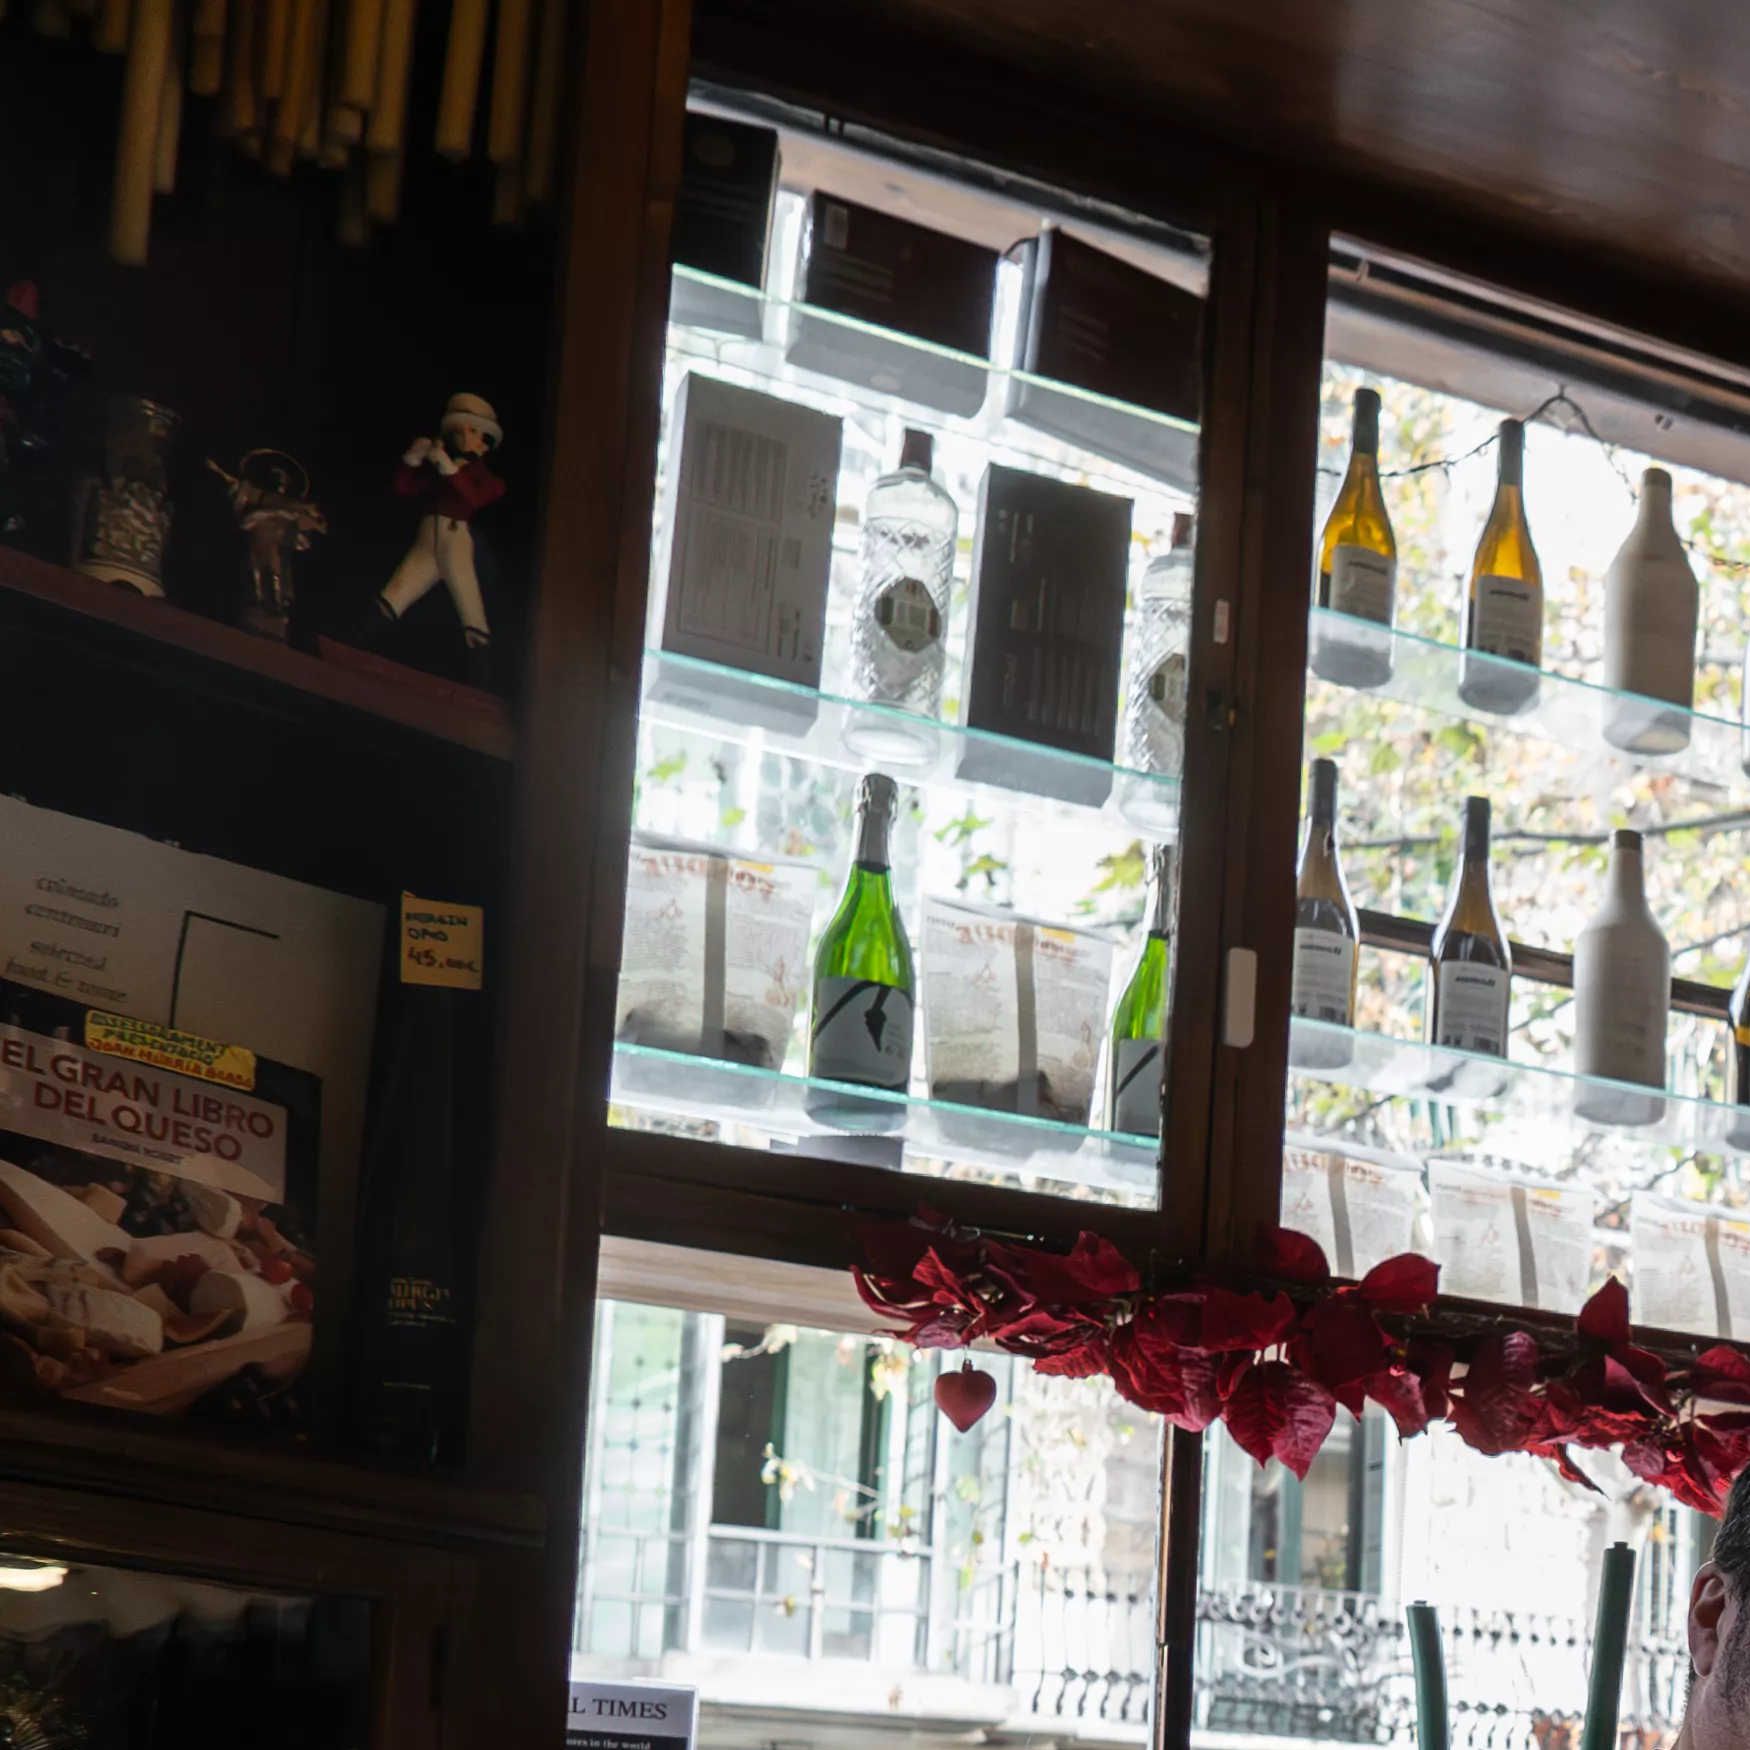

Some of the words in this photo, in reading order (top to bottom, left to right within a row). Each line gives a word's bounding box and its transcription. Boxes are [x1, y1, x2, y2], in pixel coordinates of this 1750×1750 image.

[1, 1037, 47, 1077] EL
[49, 1055, 162, 1109] GRAN
[172, 1087, 275, 1139] LIBRO
[34, 1081, 108, 1126] DEL
[111, 1104, 243, 1162] QUESO
[592, 1697, 669, 1721] TIMES
[603, 1738, 619, 1749] the
